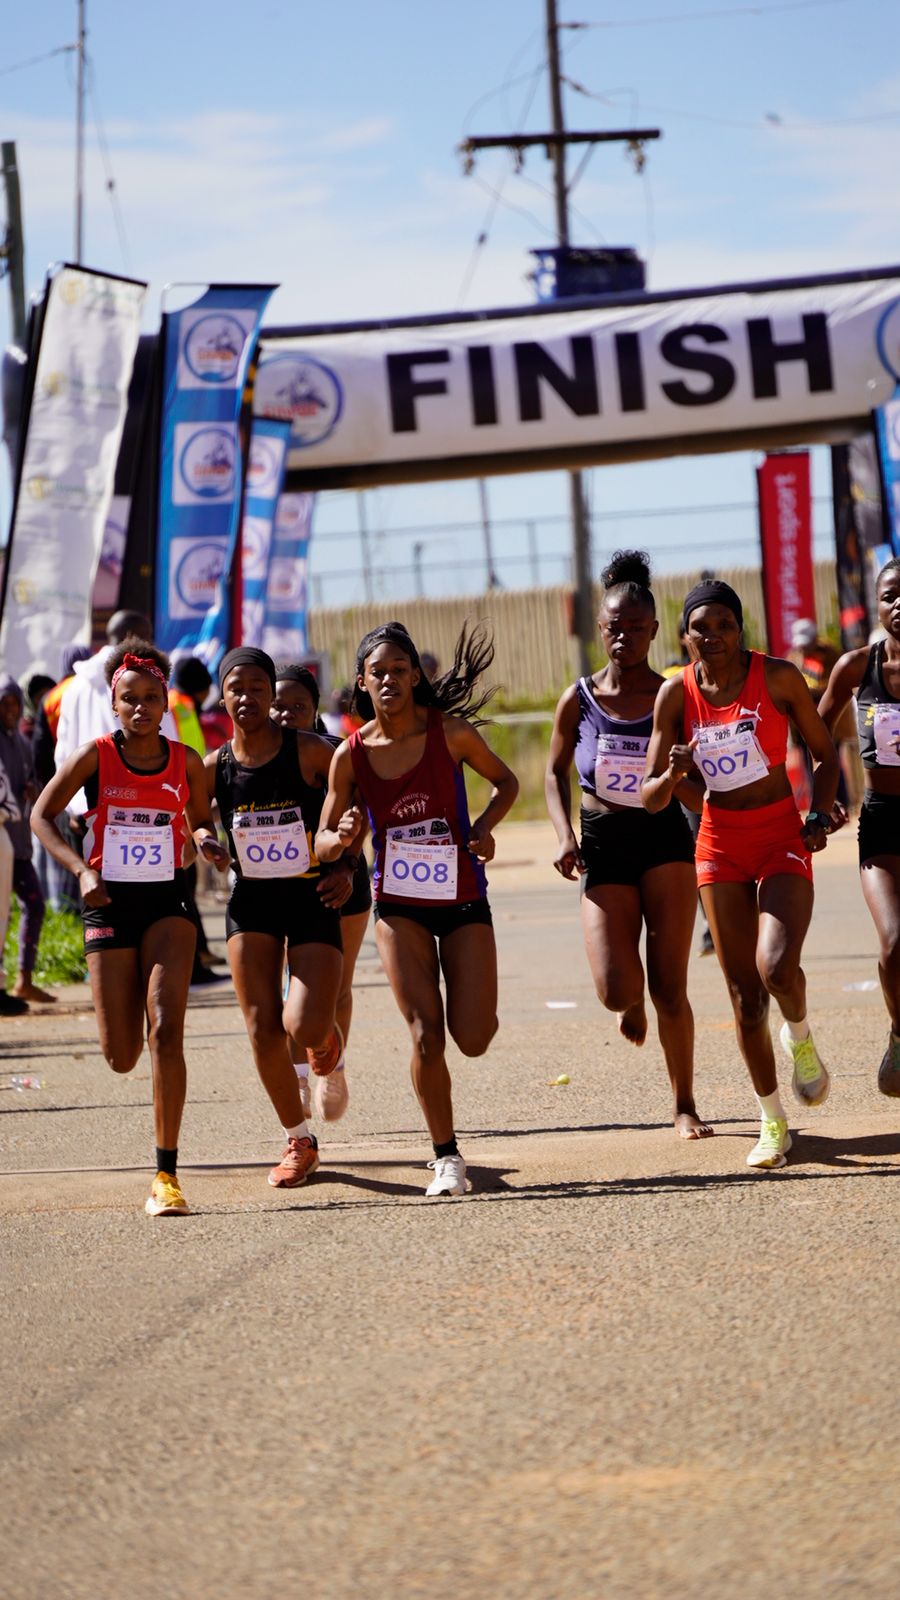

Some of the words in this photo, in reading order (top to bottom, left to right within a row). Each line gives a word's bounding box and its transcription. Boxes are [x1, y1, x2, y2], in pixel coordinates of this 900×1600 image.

[386, 312, 834, 434] FINISH
[774, 473, 800, 542] sport
[622, 741, 640, 751] 2026
[714, 729, 731, 742] 2026
[701, 750, 748, 778] 007
[606, 772, 644, 793] 22
[132, 813, 150, 824] 2026
[256, 816, 274, 826] 2026
[281, 812, 297, 821] ASA
[408, 826, 426, 838] 2026
[120, 845, 162, 866] 193
[246, 841, 299, 863] 066
[392, 859, 448, 884] 008
